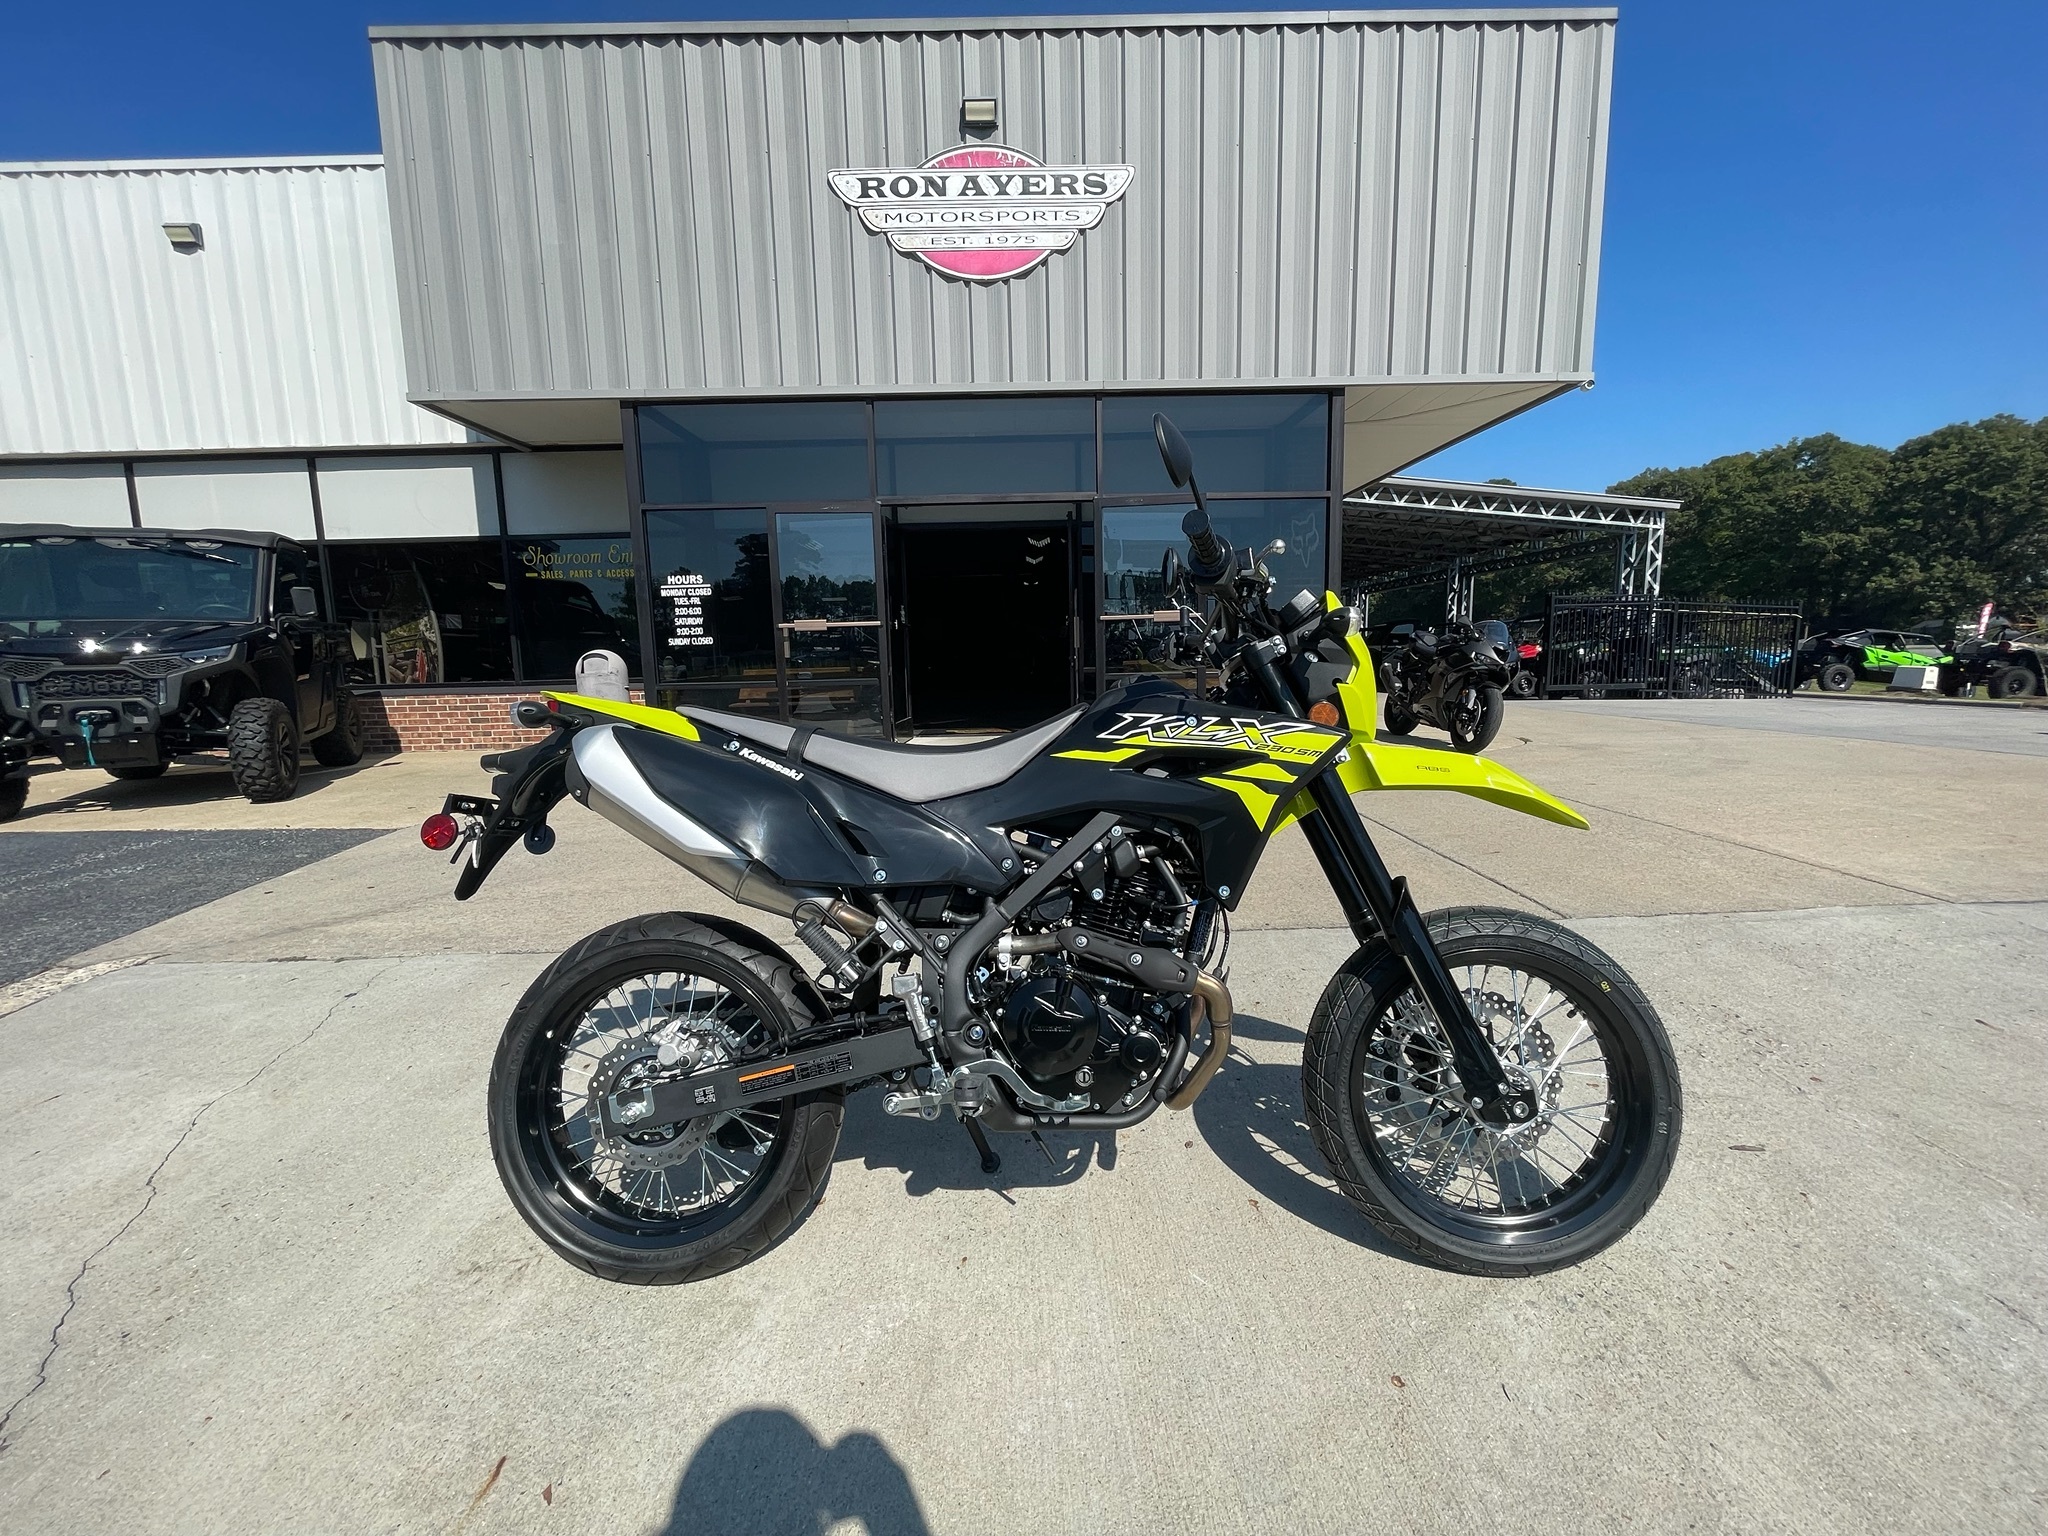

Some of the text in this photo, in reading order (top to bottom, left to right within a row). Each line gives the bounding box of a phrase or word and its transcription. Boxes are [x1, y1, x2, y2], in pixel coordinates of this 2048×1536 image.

[857, 172, 1108, 199] RON AYERS
[884, 209, 1081, 224] MOTORSPORTS
[931, 235, 1036, 246] EST. 1975
[523, 546, 601, 567] Showroom
[569, 569, 593, 578] PARTS
[667, 574, 704, 585] HOURS
[660, 588, 712, 597] MONDAY CLOSED
[674, 617, 704, 626] SATURDAY
[676, 627, 704, 636] 9:00-2:00
[668, 637, 714, 646] SUNDAY CLOSED
[738, 747, 805, 781] Kawasaki
